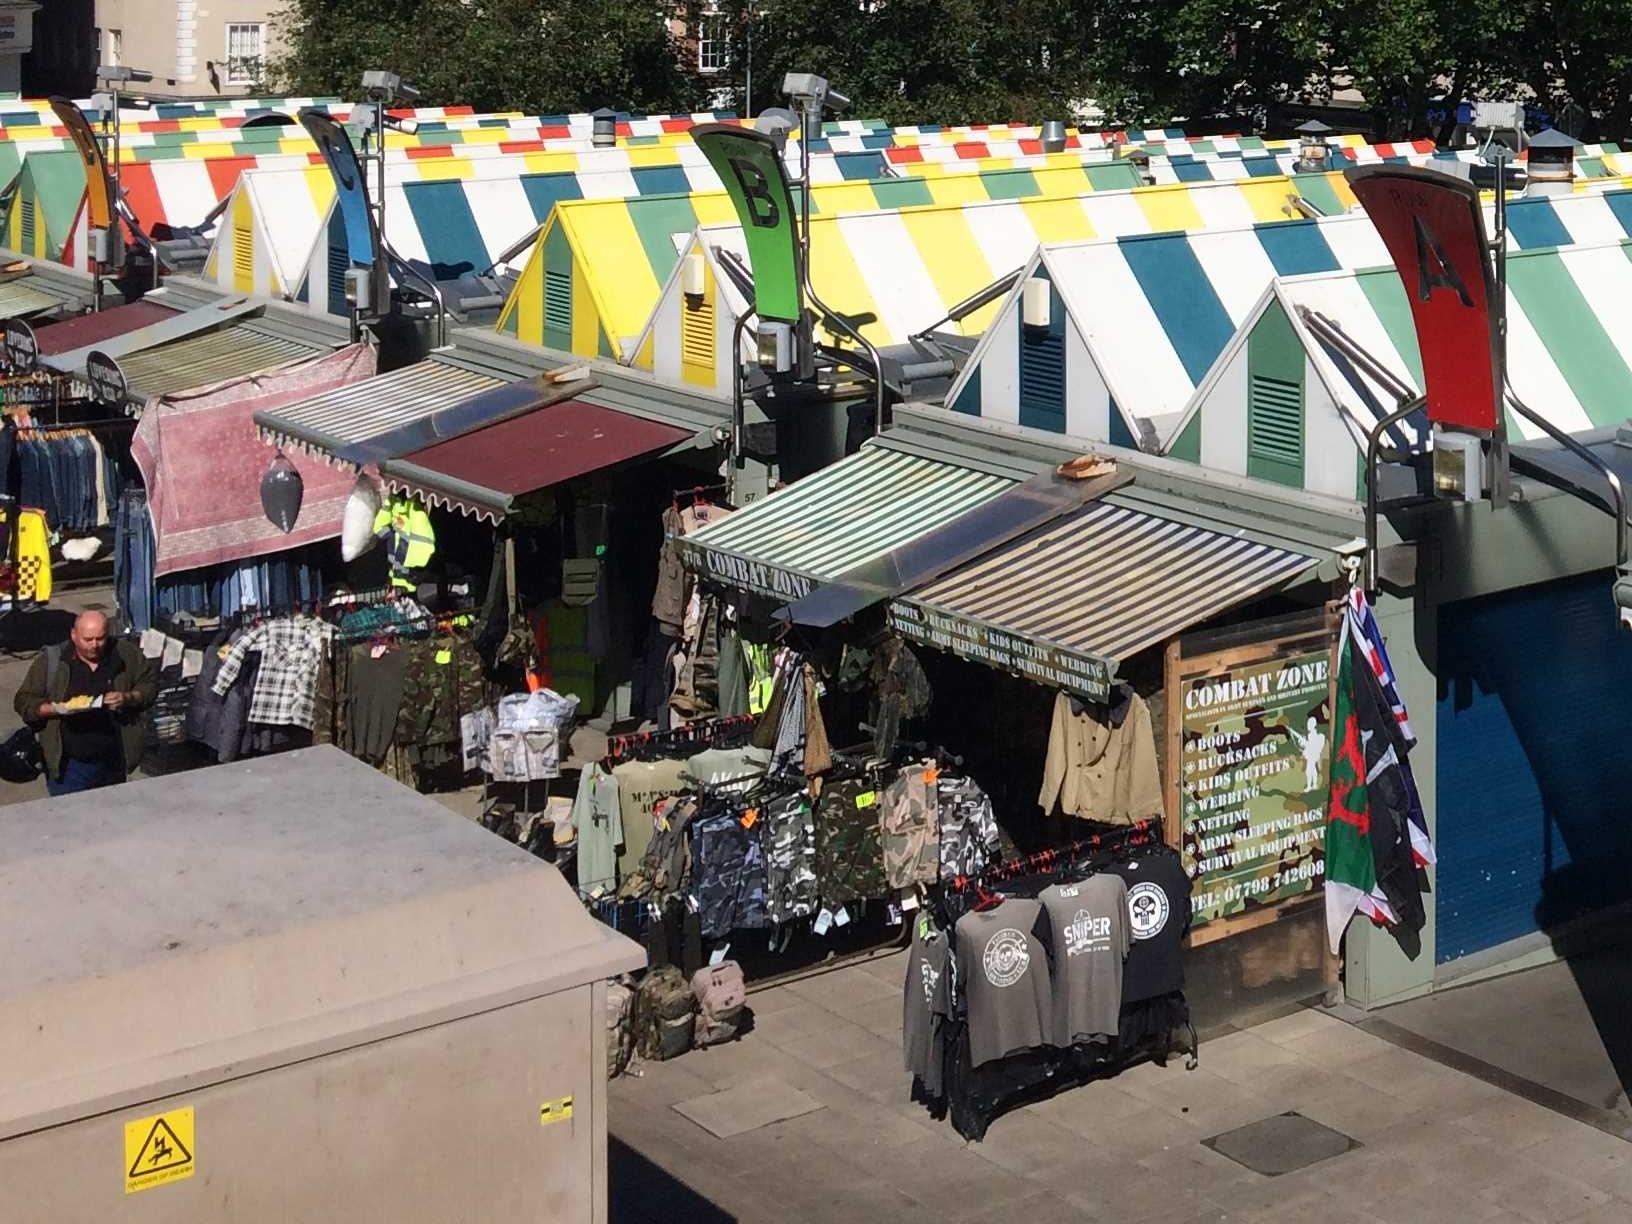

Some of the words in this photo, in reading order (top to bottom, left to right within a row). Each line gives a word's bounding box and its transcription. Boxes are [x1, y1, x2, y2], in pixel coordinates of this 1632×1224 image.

[727, 157, 780, 229] B
[1411, 214, 1475, 308] A
[744, 492, 756, 503] 57
[706, 549, 769, 588] COMBAT
[770, 568, 811, 601] ZONE
[894, 602, 919, 620] BOOTS
[928, 614, 979, 639] RUCKSACKS
[989, 632, 1011, 650] KIDS
[1011, 639, 1049, 662] OUTFITS
[1060, 654, 1104, 679] WEBBING
[894, 617, 926, 638] NETTING
[931, 630, 952, 648] ARMY
[952, 637, 990, 658] SLEEPING
[990, 647, 1011, 666] BAGS
[1016, 656, 1056, 681] SURVIVAL
[1056, 669, 1105, 696] EQUIPMENT
[1185, 672, 1272, 710] COMBAT
[1276, 660, 1328, 691] ZONE
[1197, 731, 1241, 752] BOOTS
[1198, 740, 1277, 771] RUCKSACKS
[1198, 772, 1231, 792] KIDS
[1235, 758, 1290, 781] OUTFITS
[1198, 785, 1260, 812] WEBBING
[1198, 808, 1250, 833] NETTING
[1199, 833, 1233, 853] ARMY
[1234, 817, 1291, 843] SLEEPING
[1294, 807, 1323, 826] BAGS
[1198, 845, 1259, 874] SURVIVAL
[1261, 826, 1327, 856] EQUIPMENT
[1191, 892, 1220, 913] TEL:
[1224, 876, 1270, 902] 07798
[1273, 859, 1325, 888] 742608
[1063, 916, 1111, 945] SNIPER
